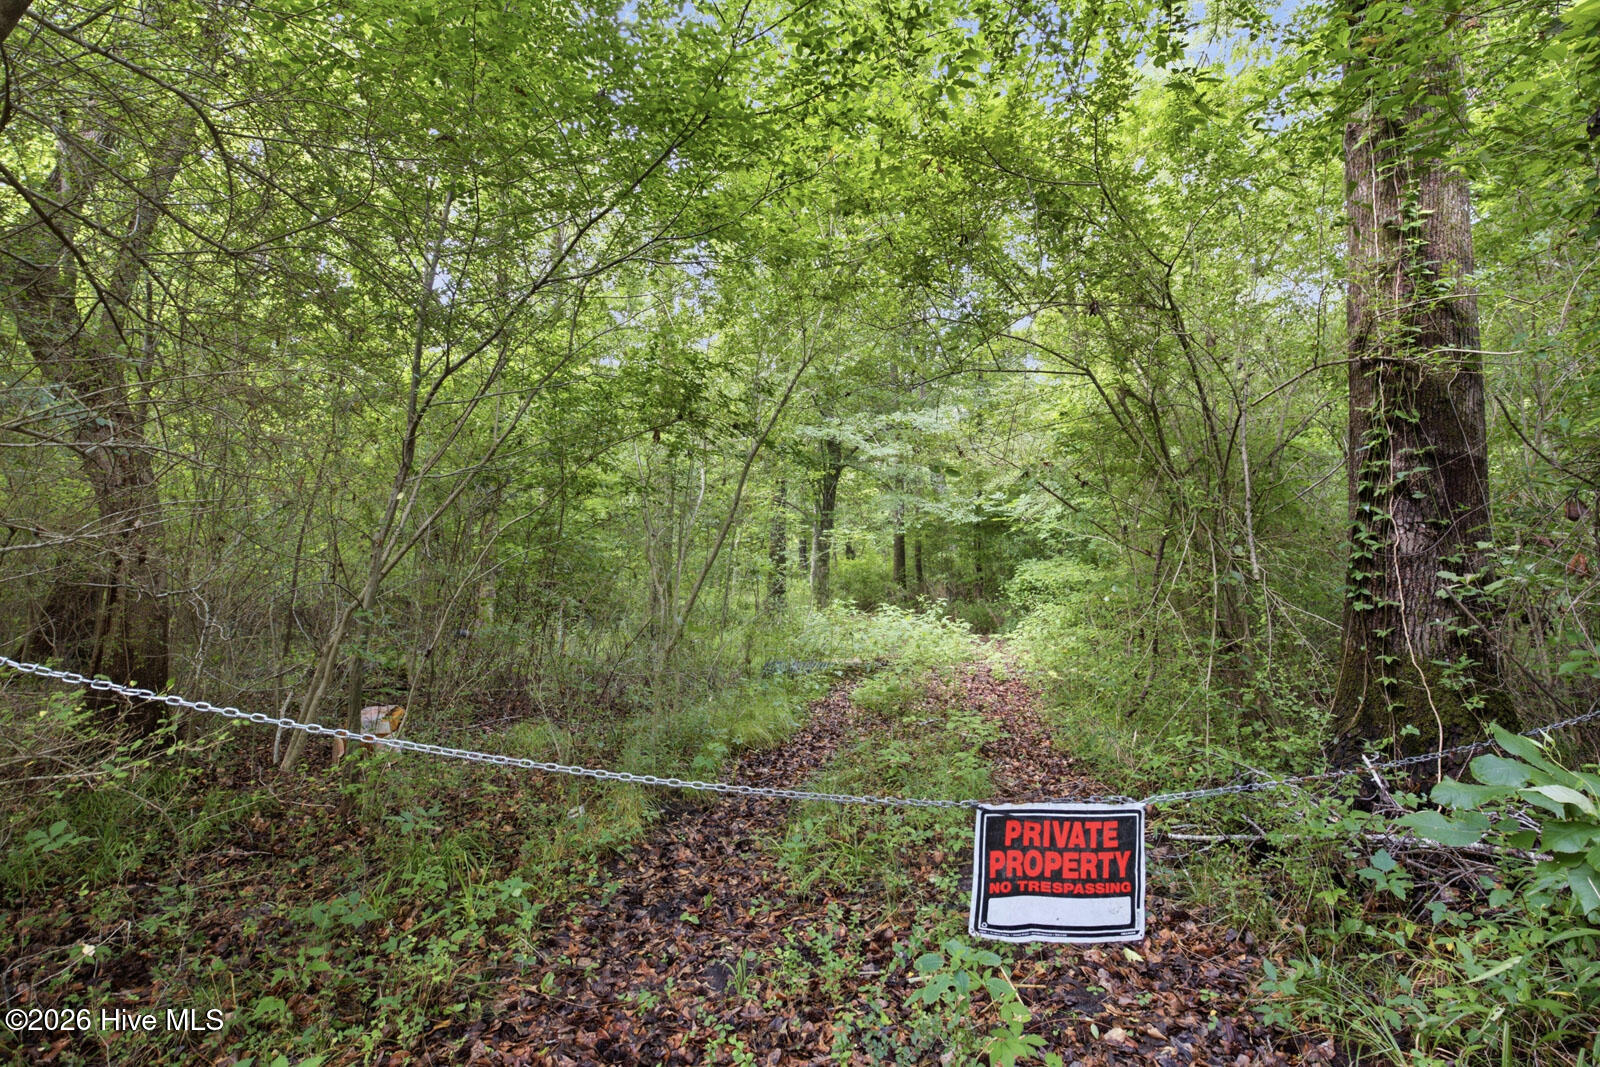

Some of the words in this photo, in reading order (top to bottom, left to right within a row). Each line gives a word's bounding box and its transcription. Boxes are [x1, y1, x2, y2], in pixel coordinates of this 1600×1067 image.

[1005, 820, 1118, 848] PRIVATE
[990, 850, 1131, 879] PROPERTY
[990, 882, 1012, 894] NO
[1017, 881, 1131, 894] TRESPASSING
